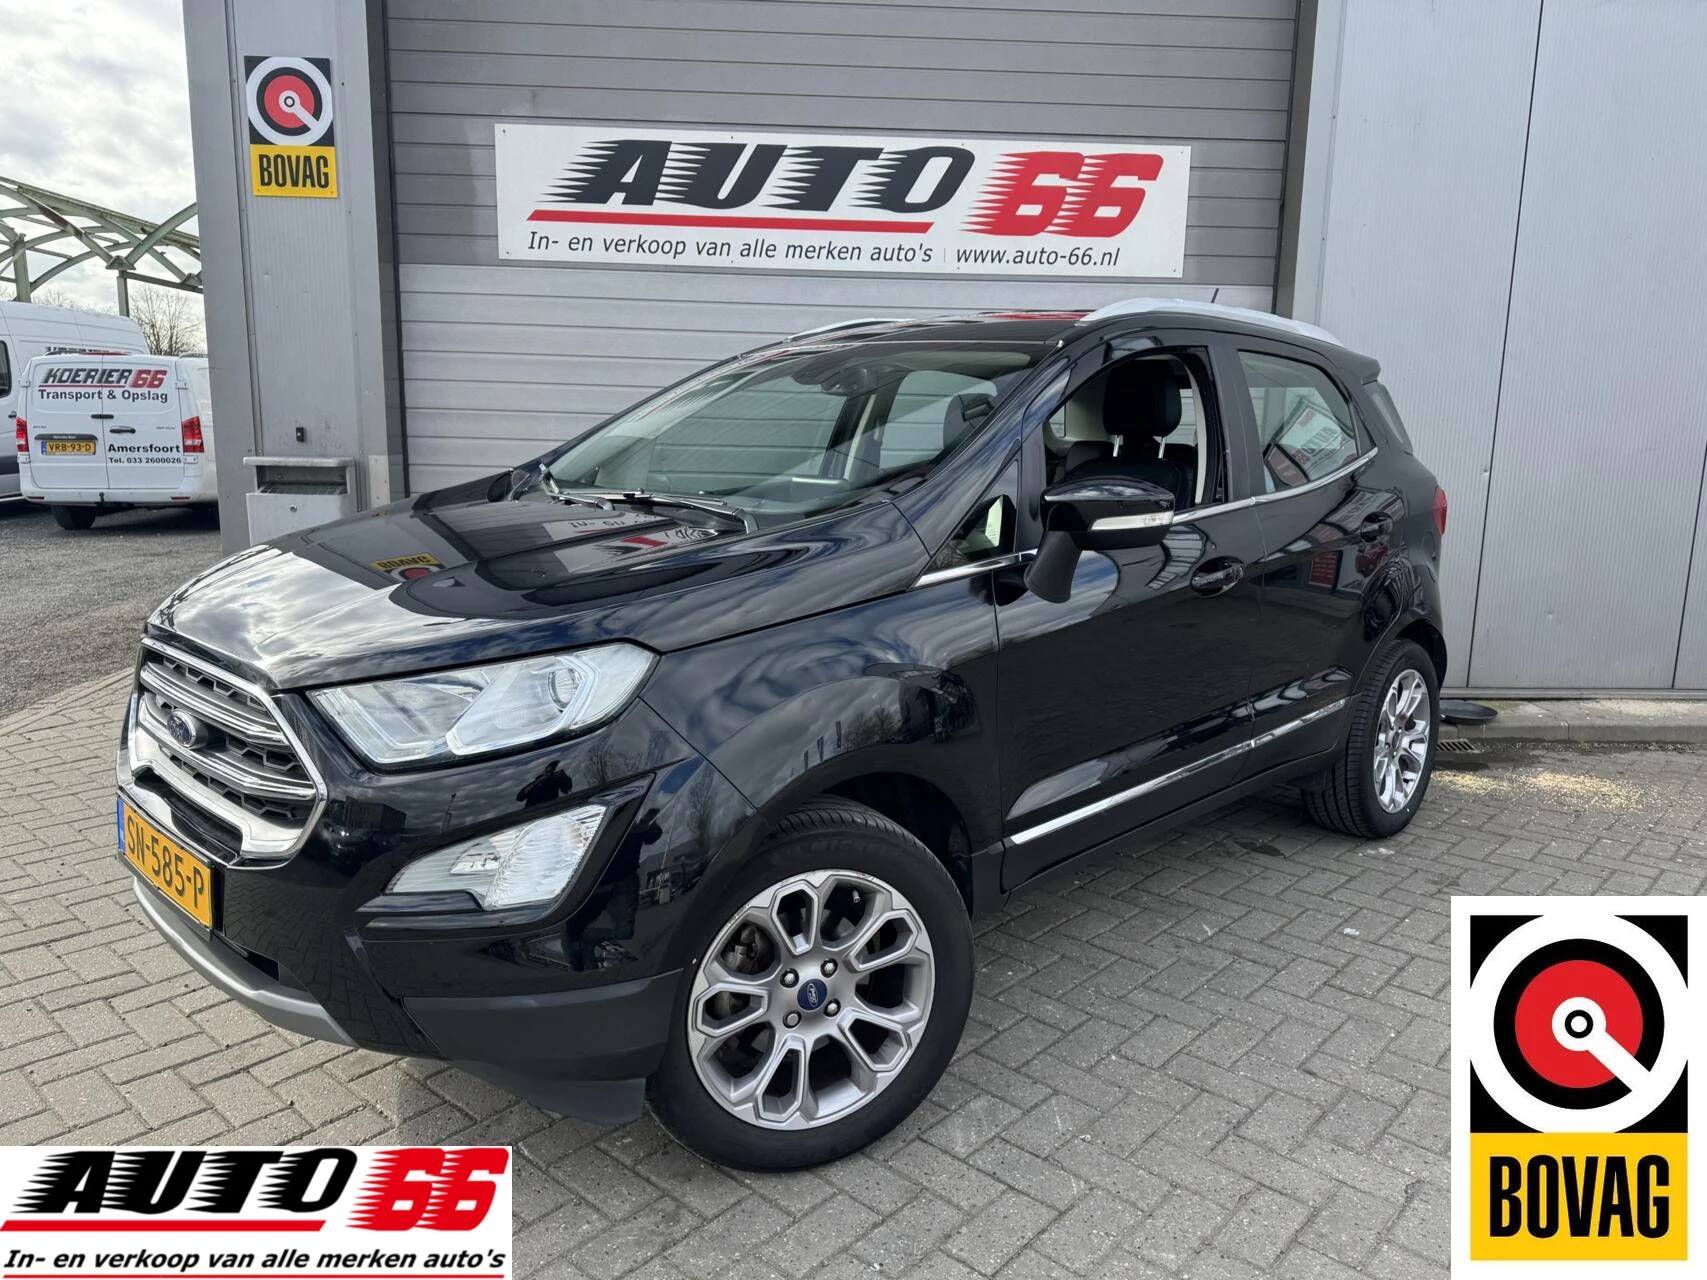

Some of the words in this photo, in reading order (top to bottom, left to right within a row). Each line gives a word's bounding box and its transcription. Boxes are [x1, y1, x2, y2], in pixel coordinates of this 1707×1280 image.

[259, 154, 330, 188] BOVAG
[535, 139, 975, 213] AUTO
[957, 151, 1164, 237] 66
[528, 231, 559, 250] In-
[568, 236, 593, 251] en
[603, 234, 687, 259] verkoop
[696, 241, 731, 257] van
[740, 238, 777, 258] alle
[785, 240, 862, 261] merken
[870, 243, 933, 263] auto's
[956, 247, 1120, 266] www.auto-66.nl
[38, 389, 103, 402] Transport
[107, 390, 116, 400] &
[122, 390, 168, 403] Opslag
[48, 443, 91, 451] VRB-93-D
[108, 444, 180, 453] Amersfoort
[126, 814, 205, 909] SN-585-P
